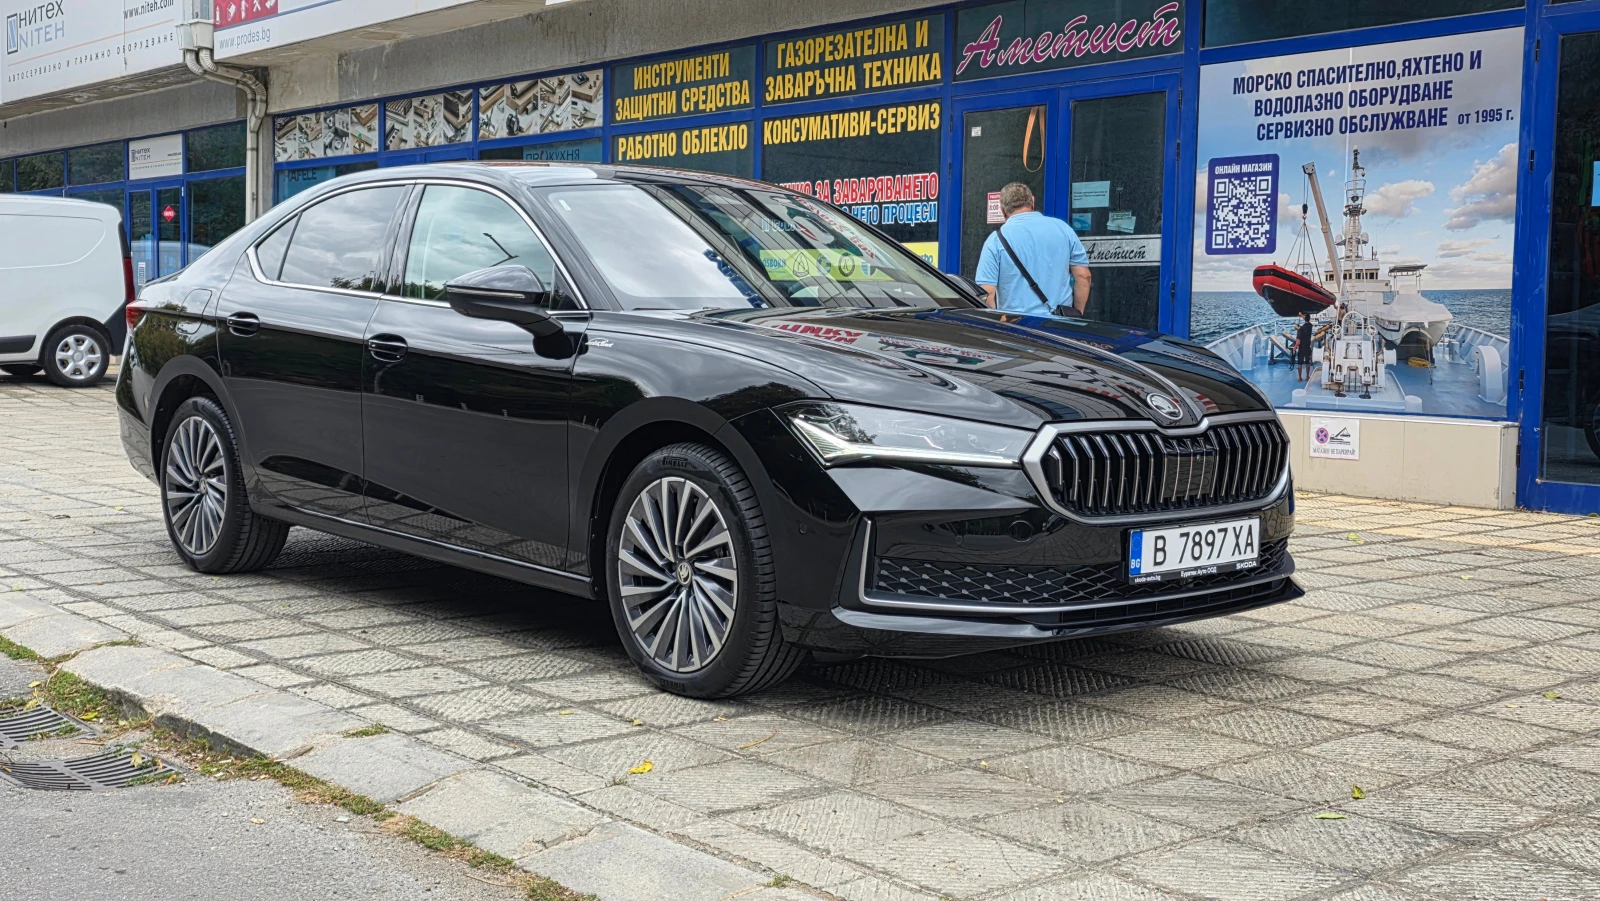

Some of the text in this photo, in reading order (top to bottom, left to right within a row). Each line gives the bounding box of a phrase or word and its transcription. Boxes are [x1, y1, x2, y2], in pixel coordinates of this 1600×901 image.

[19, 20, 65, 50] NITEH
[219, 27, 271, 49] www.prodes.bg
[777, 19, 929, 69] ГАЗОРЕЗАТЕЛНА И
[955, 1, 1182, 75] Аметист
[8, 32, 173, 82] АВТОСЕРВИЗНО И ГАРАЖНО ОБОРУДВАНЕ
[633, 52, 729, 90] ИНСТРУМЕНТИ
[1233, 49, 1482, 95] МОРСКО СПАСИТЕЛНО,ЯХТЕНО И
[765, 52, 942, 101] ЗАВАРЪЧНА ТЕХНИКА
[615, 79, 750, 121] ЗАЩИТНИ СРЕДСТВА
[1254, 80, 1453, 118] ВОДОЛАЗНО ОБОРУДВАНЕ
[763, 102, 940, 145] КОНСУМАТИВИ-СЕРВИЗ
[1256, 107, 1514, 141] СЕРВИЗНО ОБСЛУЖВАНЕ от 1995 г.
[618, 124, 748, 161] РАБОТНО ОБЛЕКЛО
[1214, 162, 1272, 174] ОНЛАЙН МАГАЗИН
[815, 180, 831, 203] ЗА
[834, 172, 939, 205] ЗАВАРЯВАНЕТО
[851, 202, 938, 226] НЕГО ПРОЦЕСИ
[1086, 242, 1147, 260] Аметист
[662, 456, 689, 467] PIRELLI
[1130, 558, 1141, 569] BG
[1153, 524, 1255, 567] B 7897 XA
